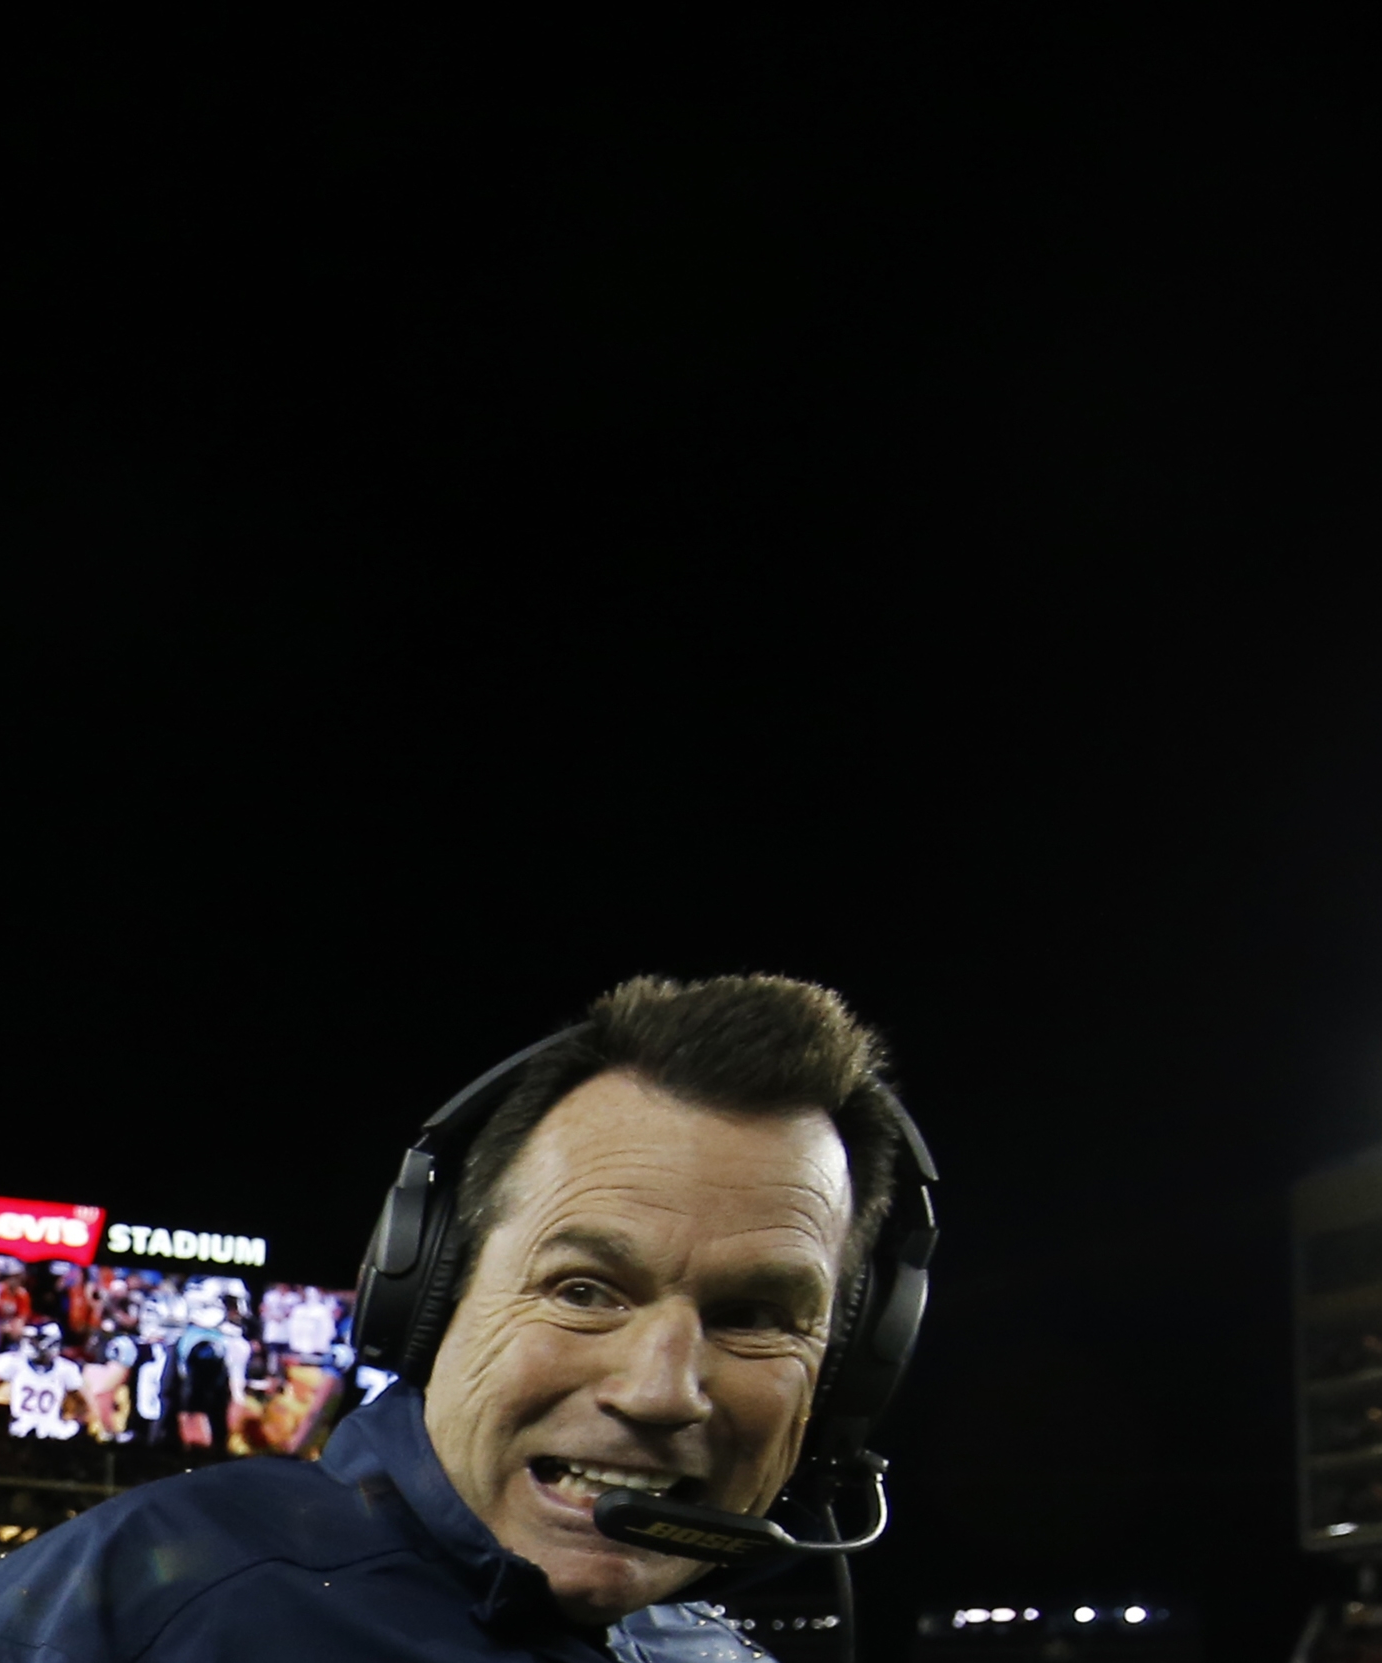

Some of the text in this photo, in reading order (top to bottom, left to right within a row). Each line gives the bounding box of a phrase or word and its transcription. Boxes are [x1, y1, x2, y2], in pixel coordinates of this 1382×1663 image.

[107, 1222, 266, 1267] STADIUM
[20, 1385, 56, 1416] 20
[645, 1521, 750, 1554] BOSE
